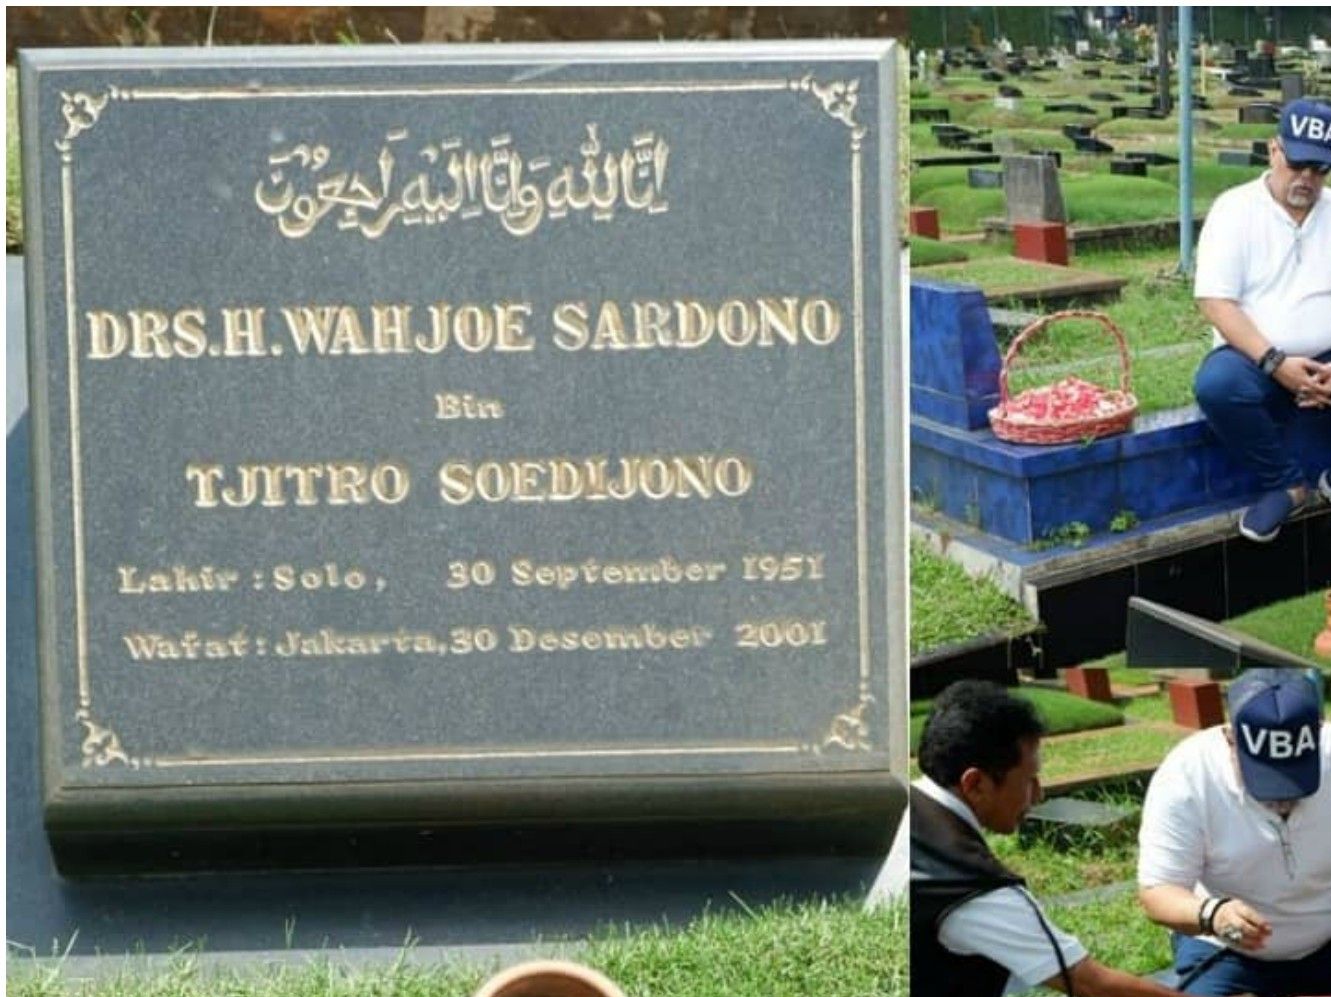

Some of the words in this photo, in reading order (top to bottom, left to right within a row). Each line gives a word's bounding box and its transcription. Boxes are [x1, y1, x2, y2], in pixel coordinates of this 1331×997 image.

[551, 298, 843, 353] SARDONO
[434, 393, 504, 421] Bin
[186, 461, 411, 509] TJITRO
[437, 456, 754, 506] SOEDIJONO
[446, 559, 498, 589] 30
[509, 556, 728, 590] September
[740, 552, 826, 582] 1951
[506, 622, 714, 654] Desember
[733, 619, 829, 648] 2001
[1240, 722, 1317, 760] VBA
